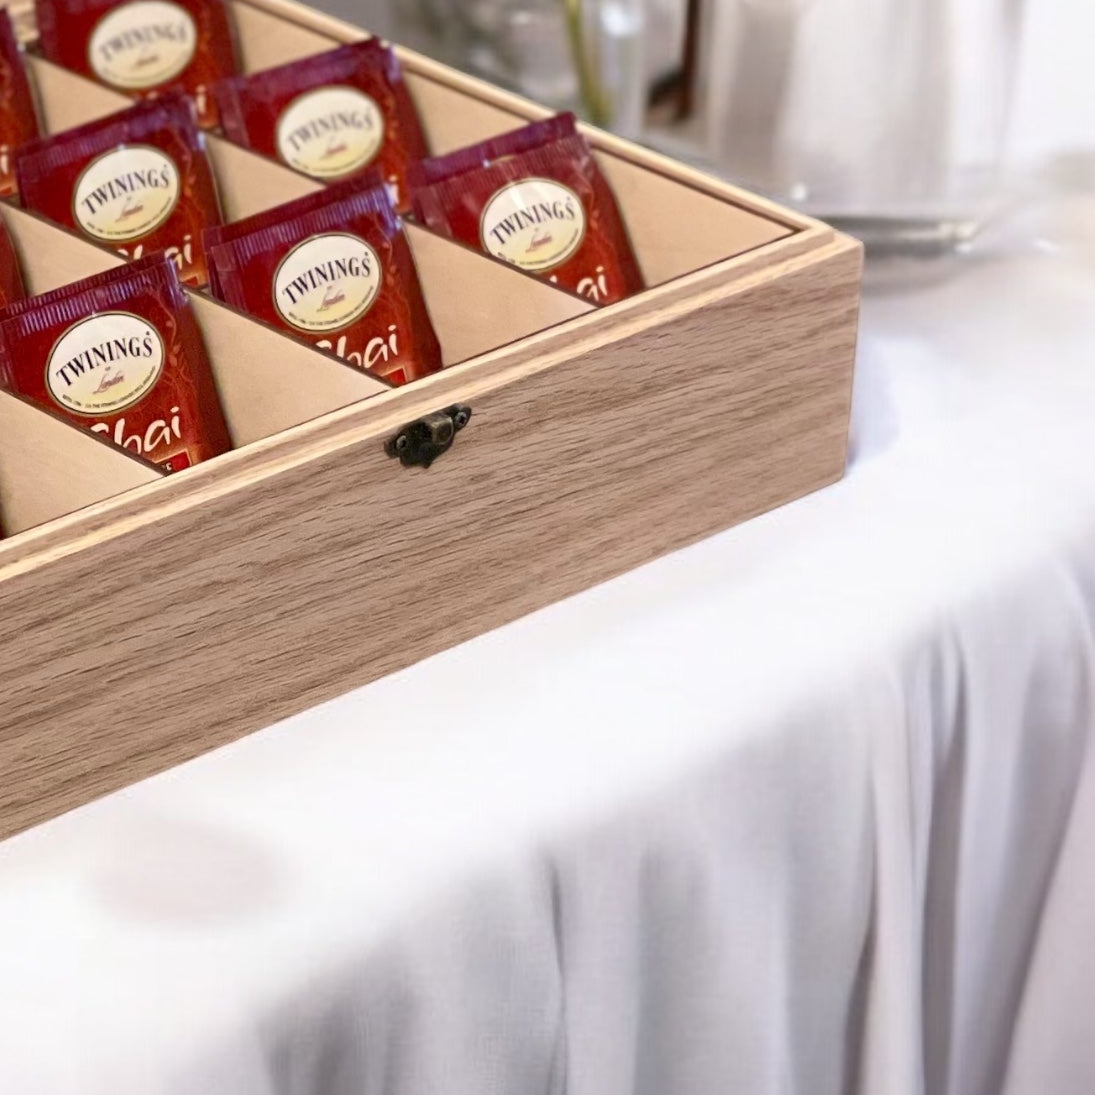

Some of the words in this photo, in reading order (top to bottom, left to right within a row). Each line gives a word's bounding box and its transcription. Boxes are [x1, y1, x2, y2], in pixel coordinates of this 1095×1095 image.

[81, 168, 170, 215] TWININGS
[490, 200, 576, 245] TWININGS
[282, 256, 371, 304] TWININGS
[56, 336, 153, 386] TWININGS
